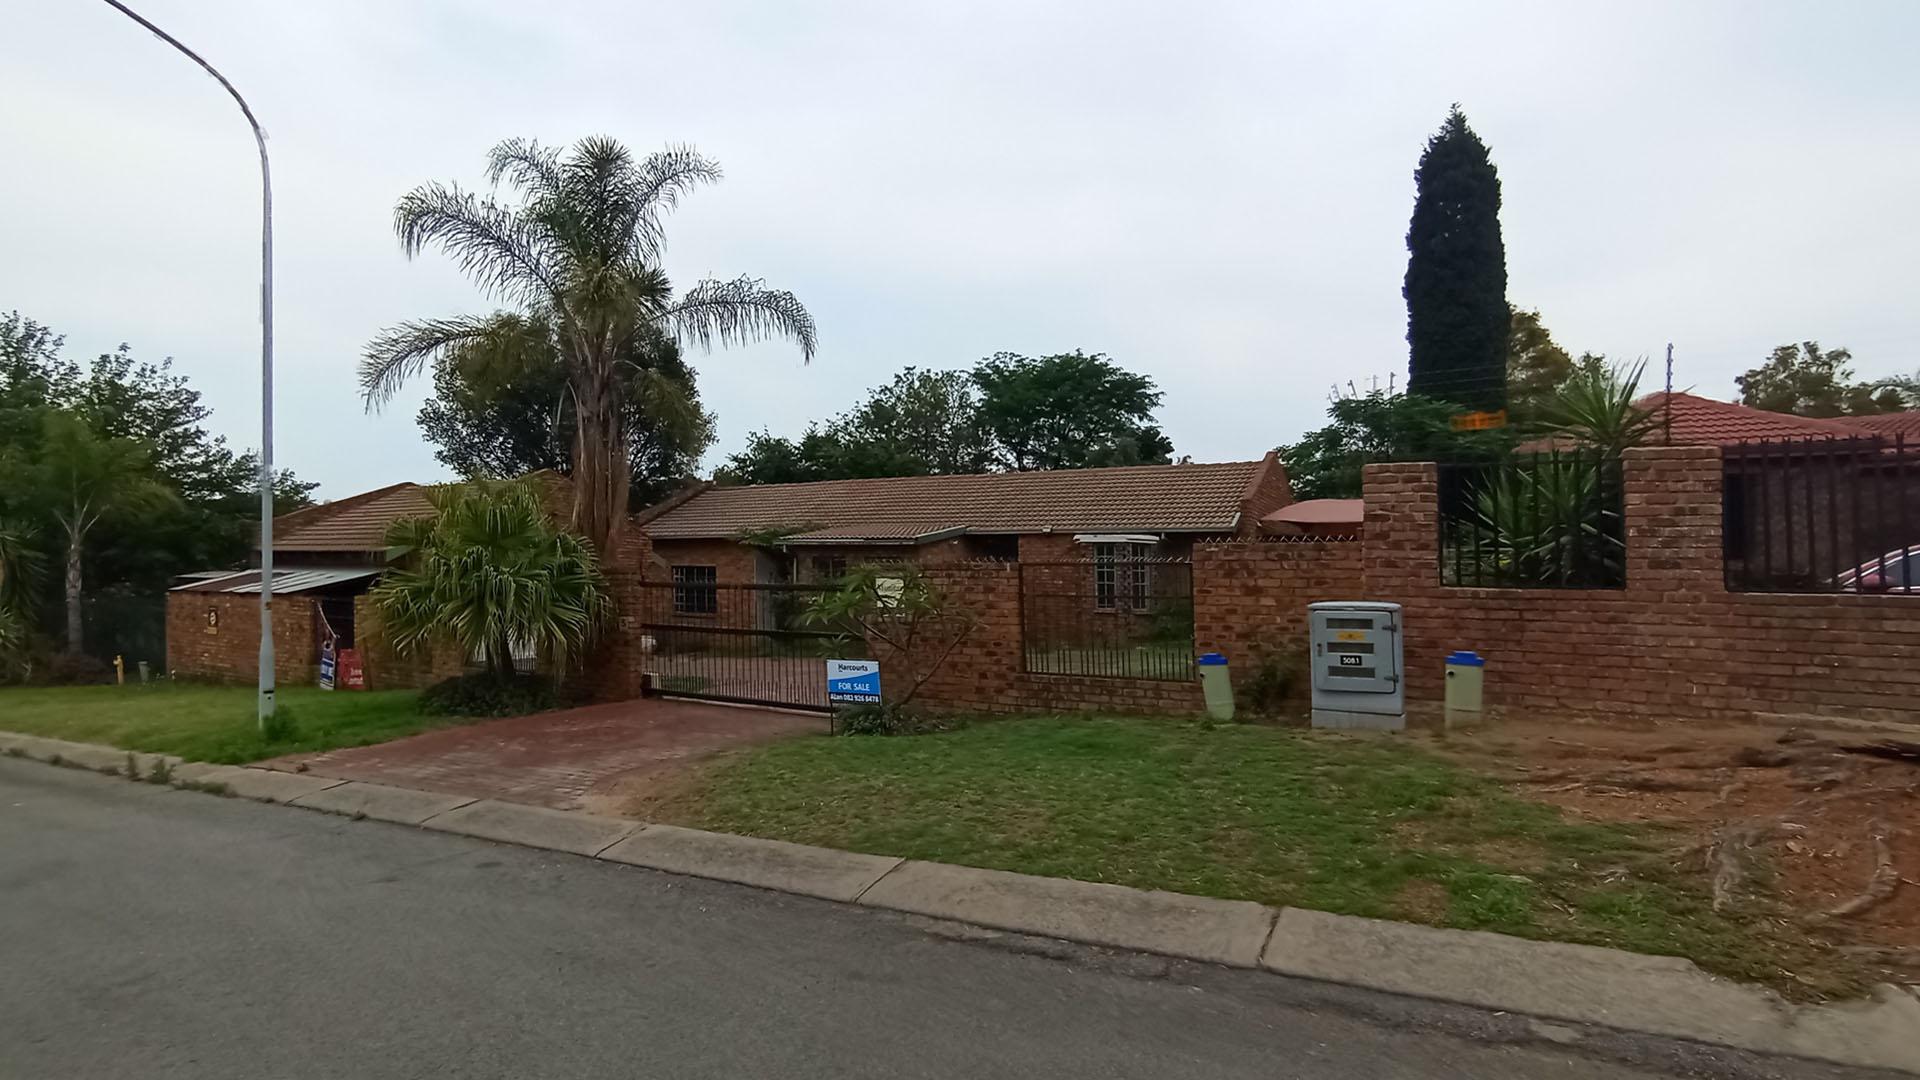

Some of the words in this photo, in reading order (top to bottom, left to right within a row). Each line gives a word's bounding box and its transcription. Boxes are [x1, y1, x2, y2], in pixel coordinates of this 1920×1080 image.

[838, 664, 868, 672] Harcourts
[838, 682, 851, 690] FOR
[853, 683, 870, 691] SALE
